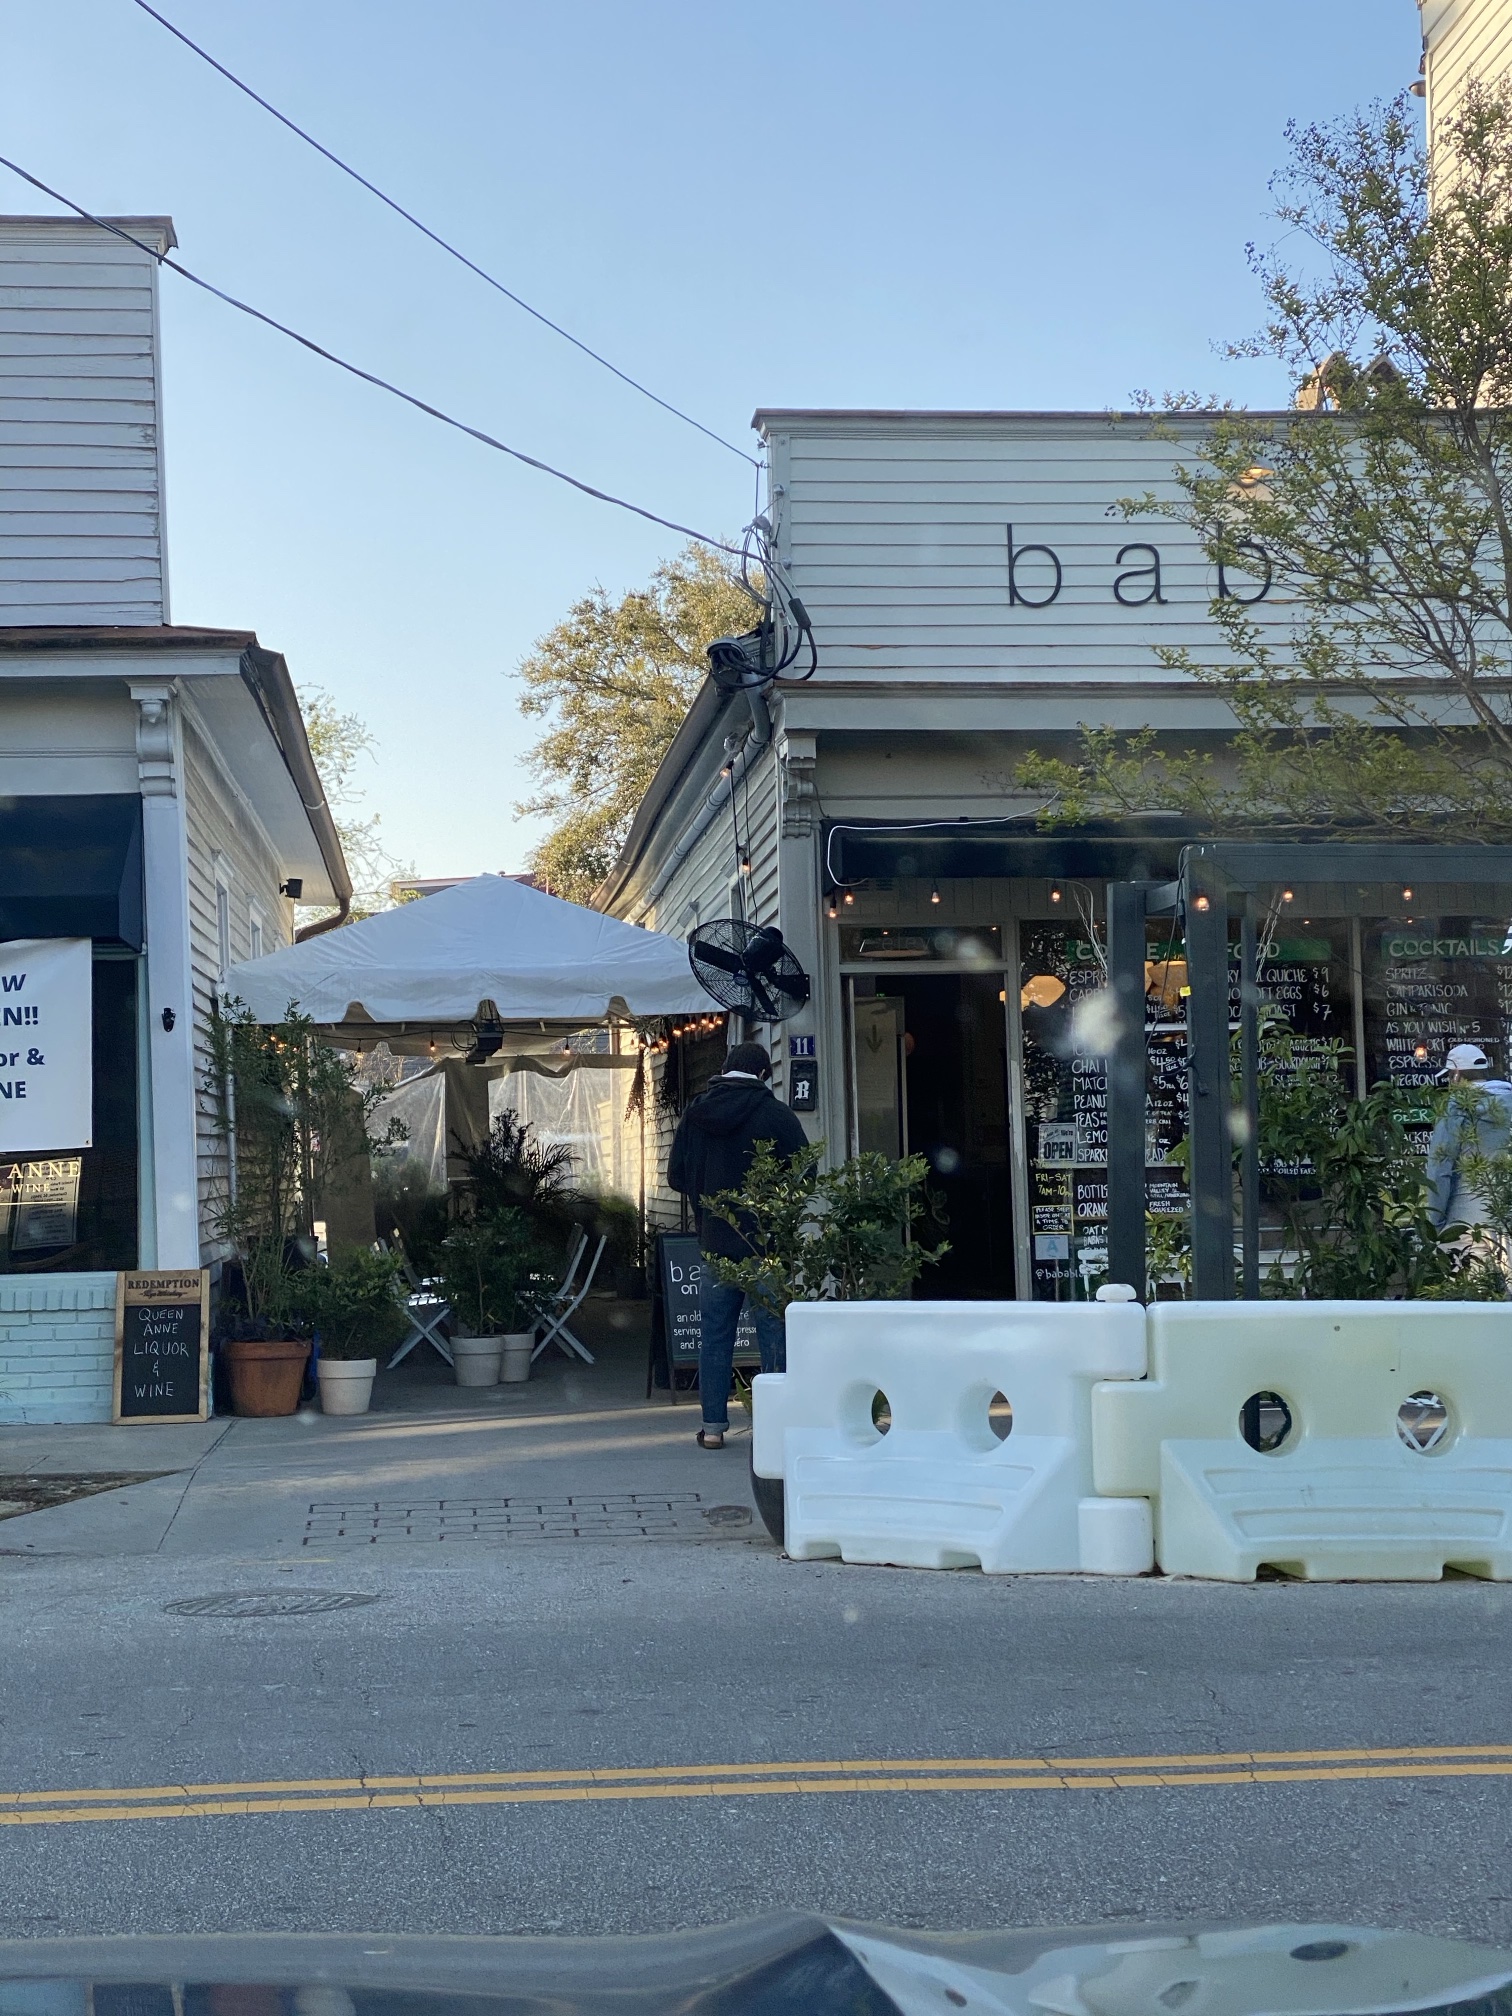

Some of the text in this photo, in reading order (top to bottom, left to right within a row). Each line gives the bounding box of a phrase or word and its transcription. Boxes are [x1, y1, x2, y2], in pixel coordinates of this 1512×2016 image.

[1389, 939, 1500, 957] COCKTAILS
[1266, 968, 1308, 982] QUICHE
[1313, 966, 1329, 982] $9
[1386, 967, 1428, 980] SPRITZ
[1276, 986, 1303, 1000] EGGS
[1314, 984, 1330, 998] $6
[1313, 1001, 1332, 1020] $7
[1386, 1002, 1408, 1016] GIN
[1386, 1022, 1399, 1034] AS
[1402, 1021, 1424, 1034] YOU
[1427, 1020, 1457, 1034] WISH
[796, 1037, 809, 1055] 11
[26, 1048, 45, 1066] &
[1072, 1111, 1100, 1128] TEAS
[1043, 1141, 1073, 1160] OPEN
[7, 1161, 80, 1179] ANNE
[12, 1183, 51, 1194] WINE
[127, 1278, 200, 1290] REDEMPTION
[138, 1307, 184, 1322] QUEEN
[676, 1314, 688, 1323] an
[143, 1322, 179, 1337] ANNE
[673, 1327, 702, 1337] serving
[133, 1340, 190, 1358] LIQUOR
[680, 1338, 695, 1350] and
[134, 1381, 175, 1398] WINE
